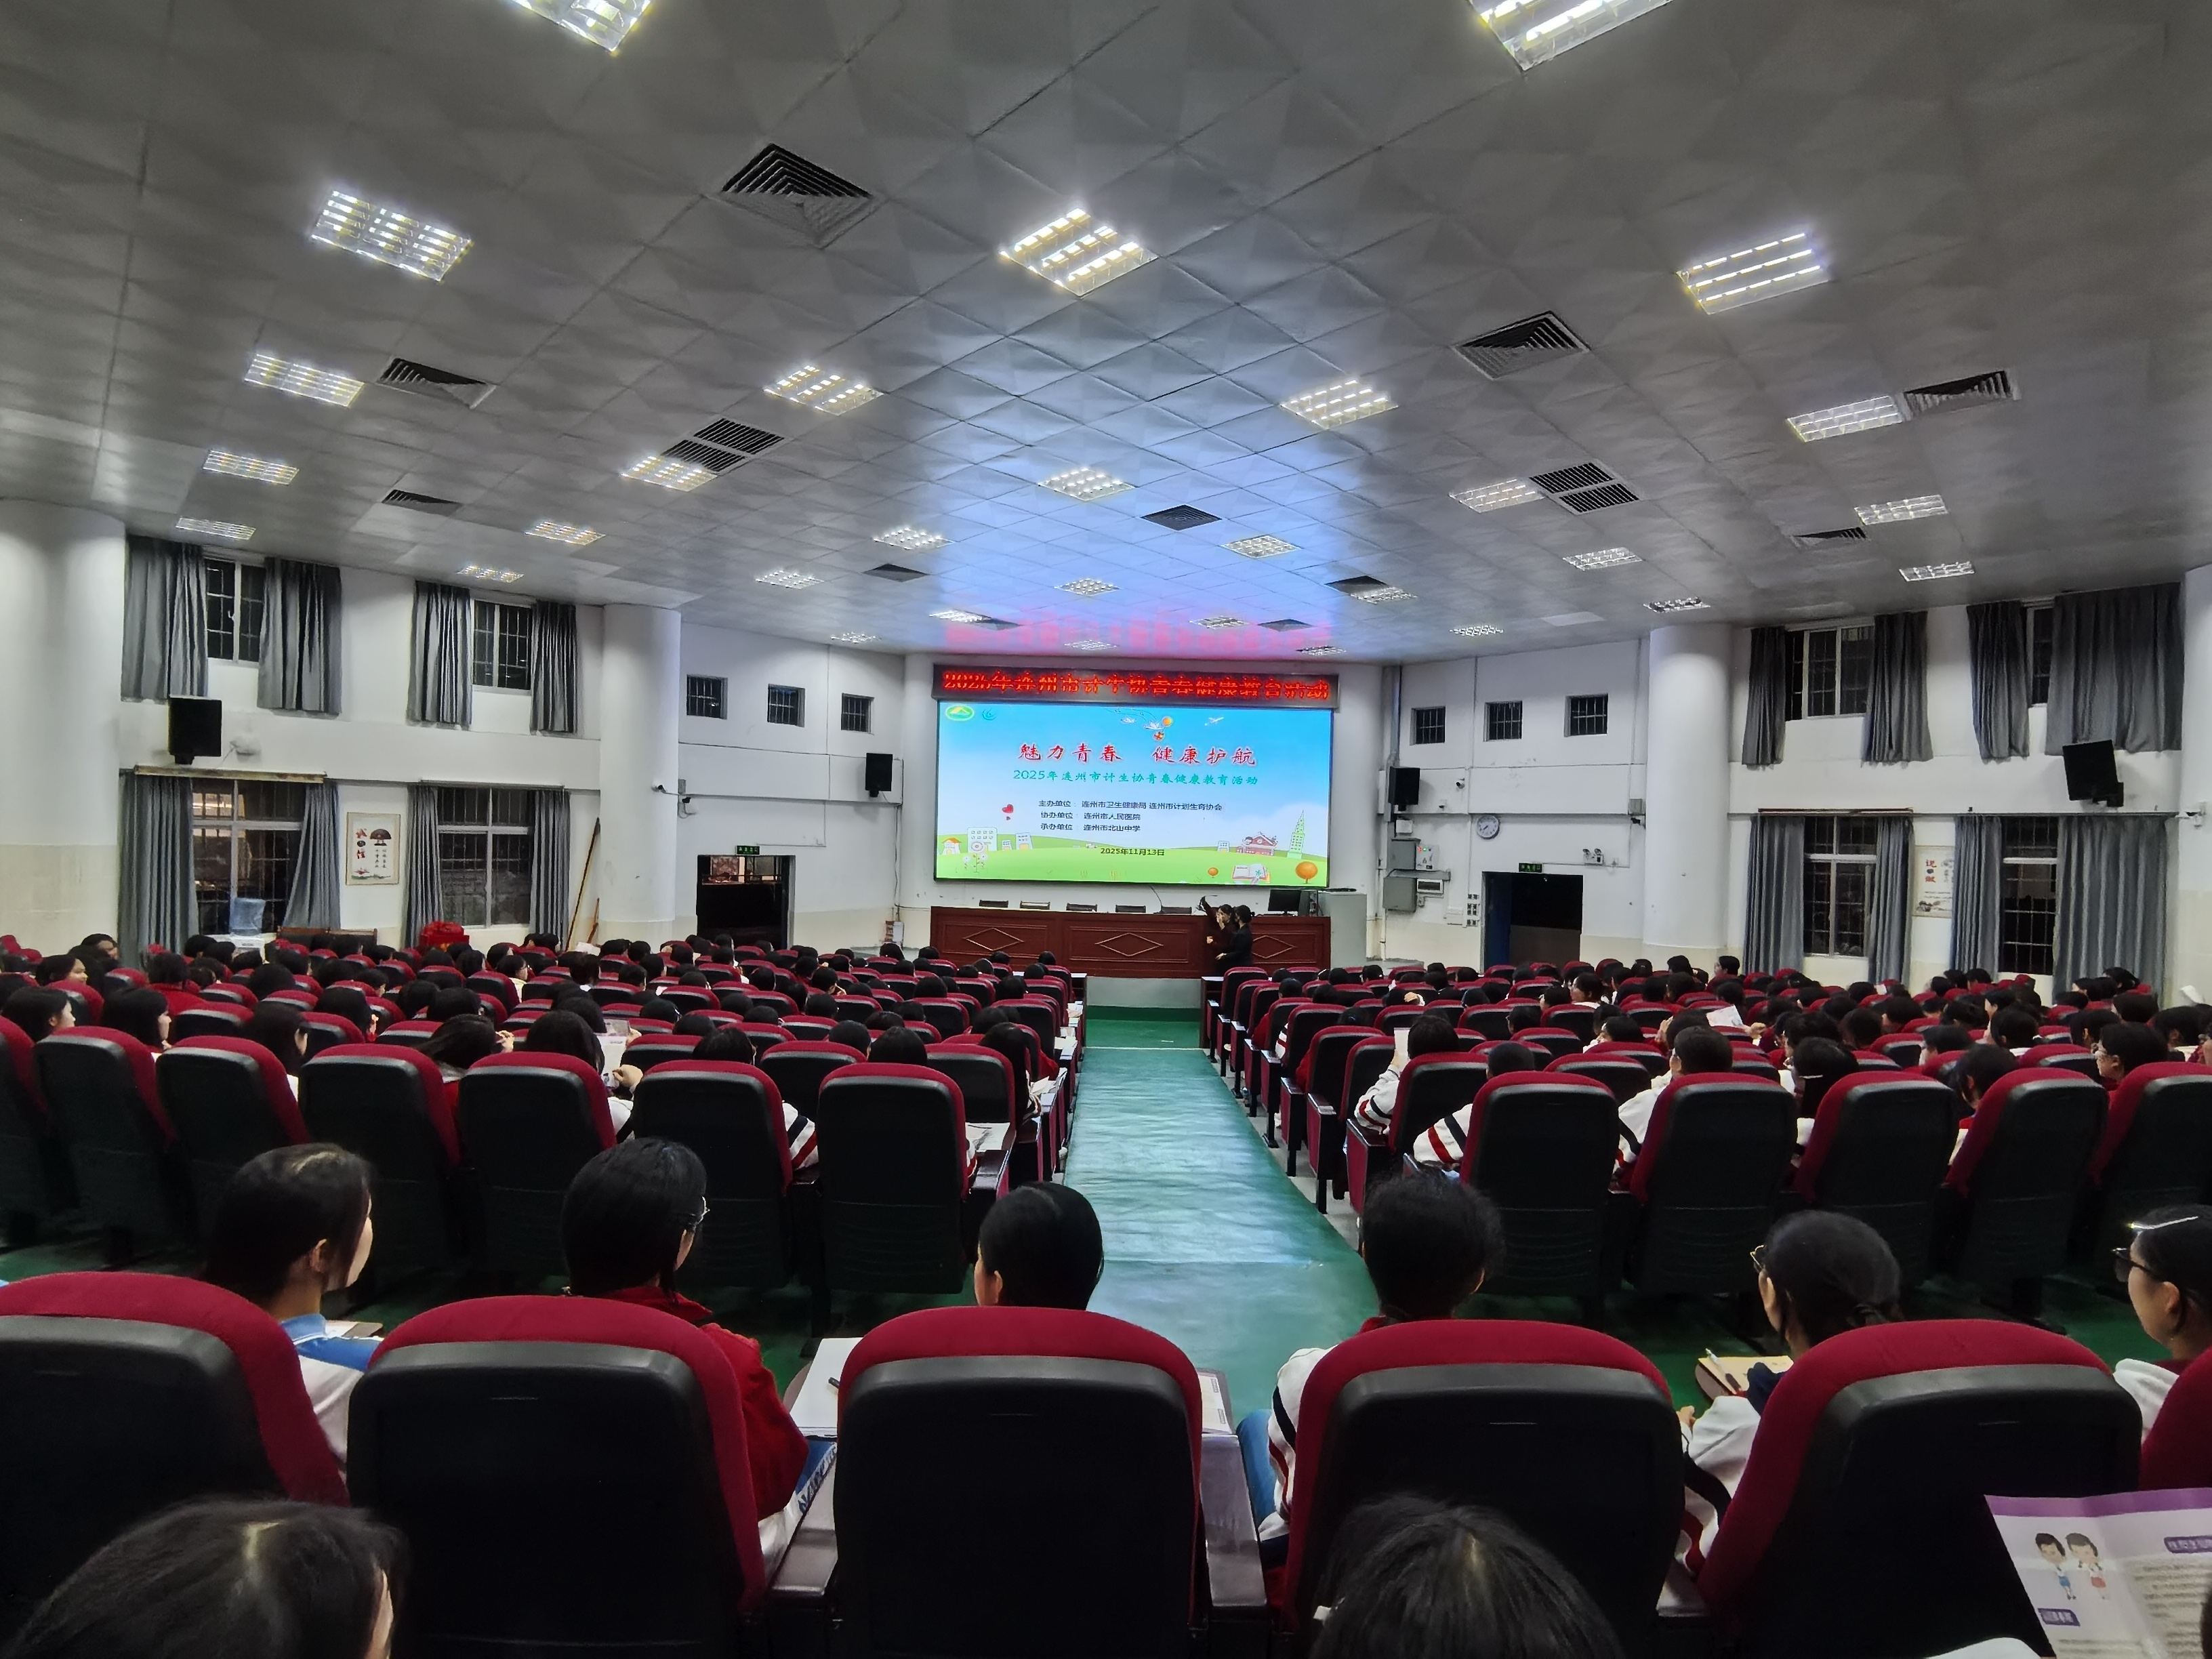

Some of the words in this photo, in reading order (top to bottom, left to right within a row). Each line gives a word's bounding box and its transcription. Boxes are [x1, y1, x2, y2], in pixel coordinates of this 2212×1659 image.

[1017, 742, 1124, 763] 魅力青春
[1152, 746, 1256, 765] 健康护航
[1013, 769, 1258, 785] 2025年连州市计生协青春健康教育活动
[1082, 800, 1147, 809] 连州市卫生健康局
[1149, 802, 1223, 811] 连州市计划生育协会
[1084, 813, 1141, 821] 连州市人民医院
[1084, 824, 1141, 832] 连州市北山中学
[1101, 848, 1165, 856] 2025年11月13日
